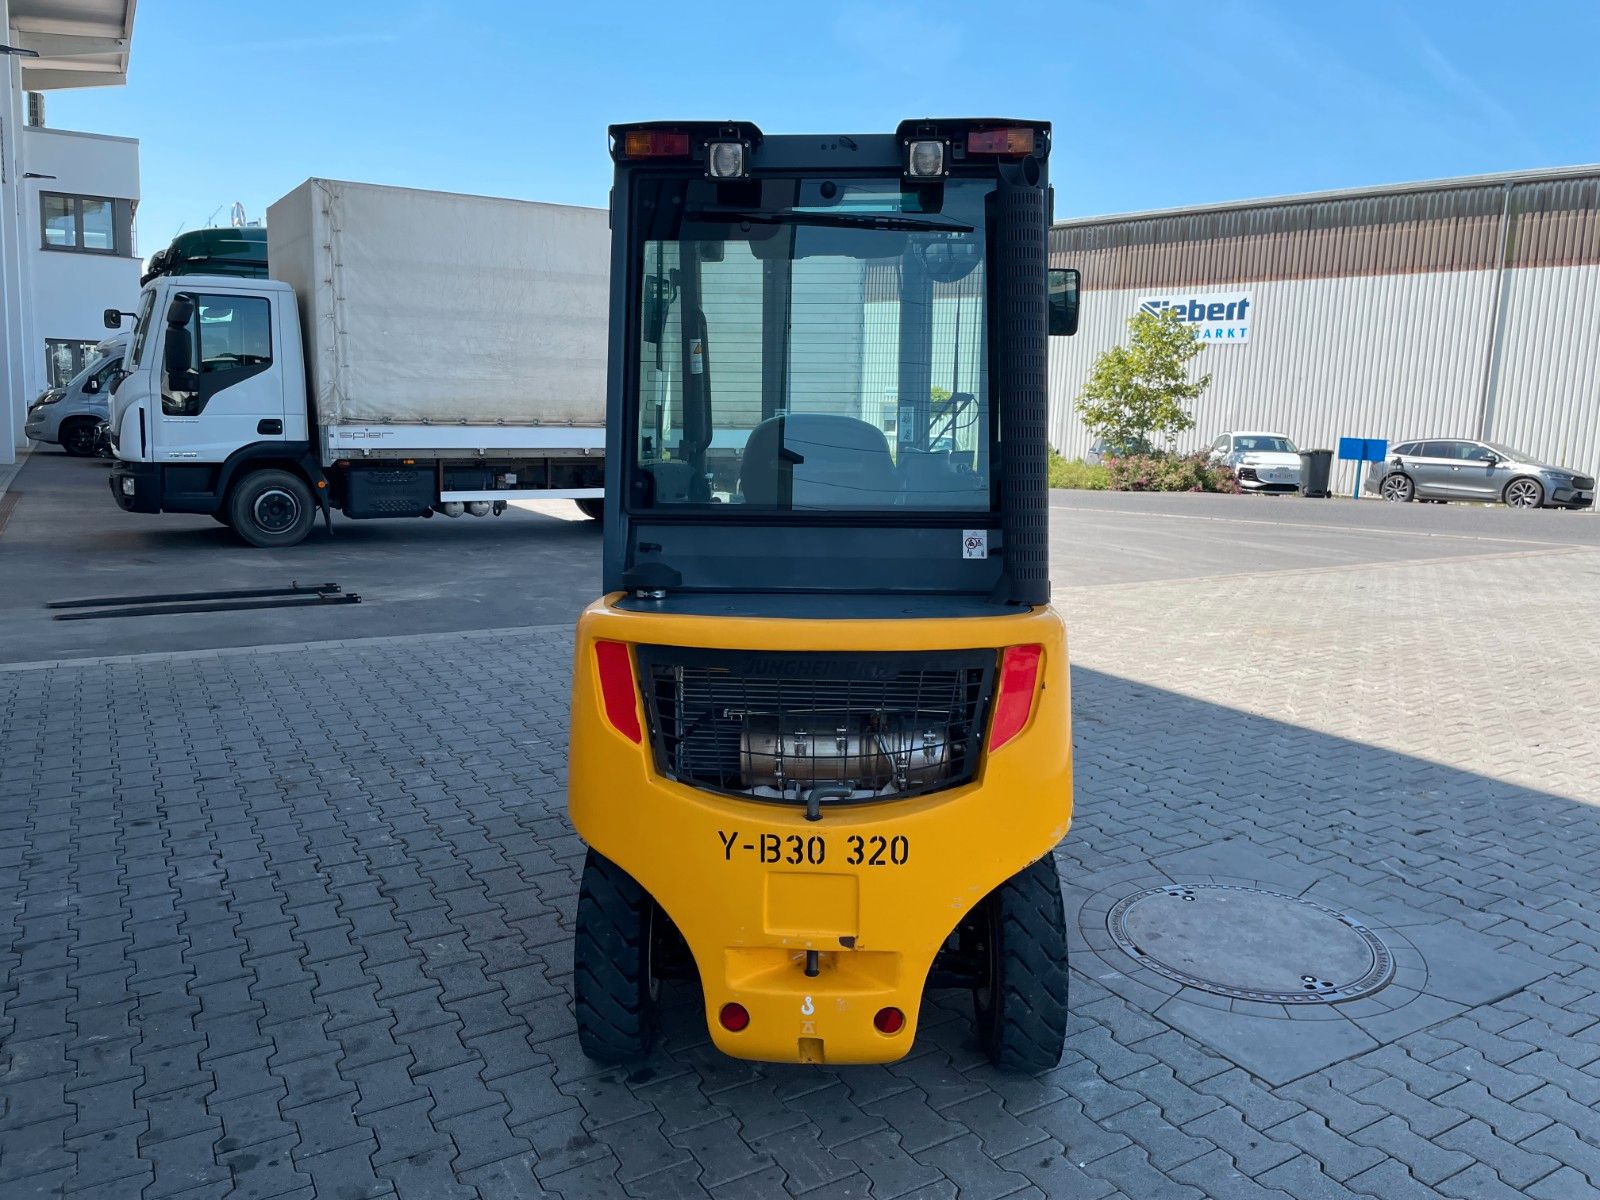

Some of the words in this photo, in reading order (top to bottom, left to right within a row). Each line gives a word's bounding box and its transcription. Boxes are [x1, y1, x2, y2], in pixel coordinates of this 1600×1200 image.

[339, 428, 394, 440] spier
[718, 831, 826, 865] Y-B30
[846, 835, 909, 866] 320
